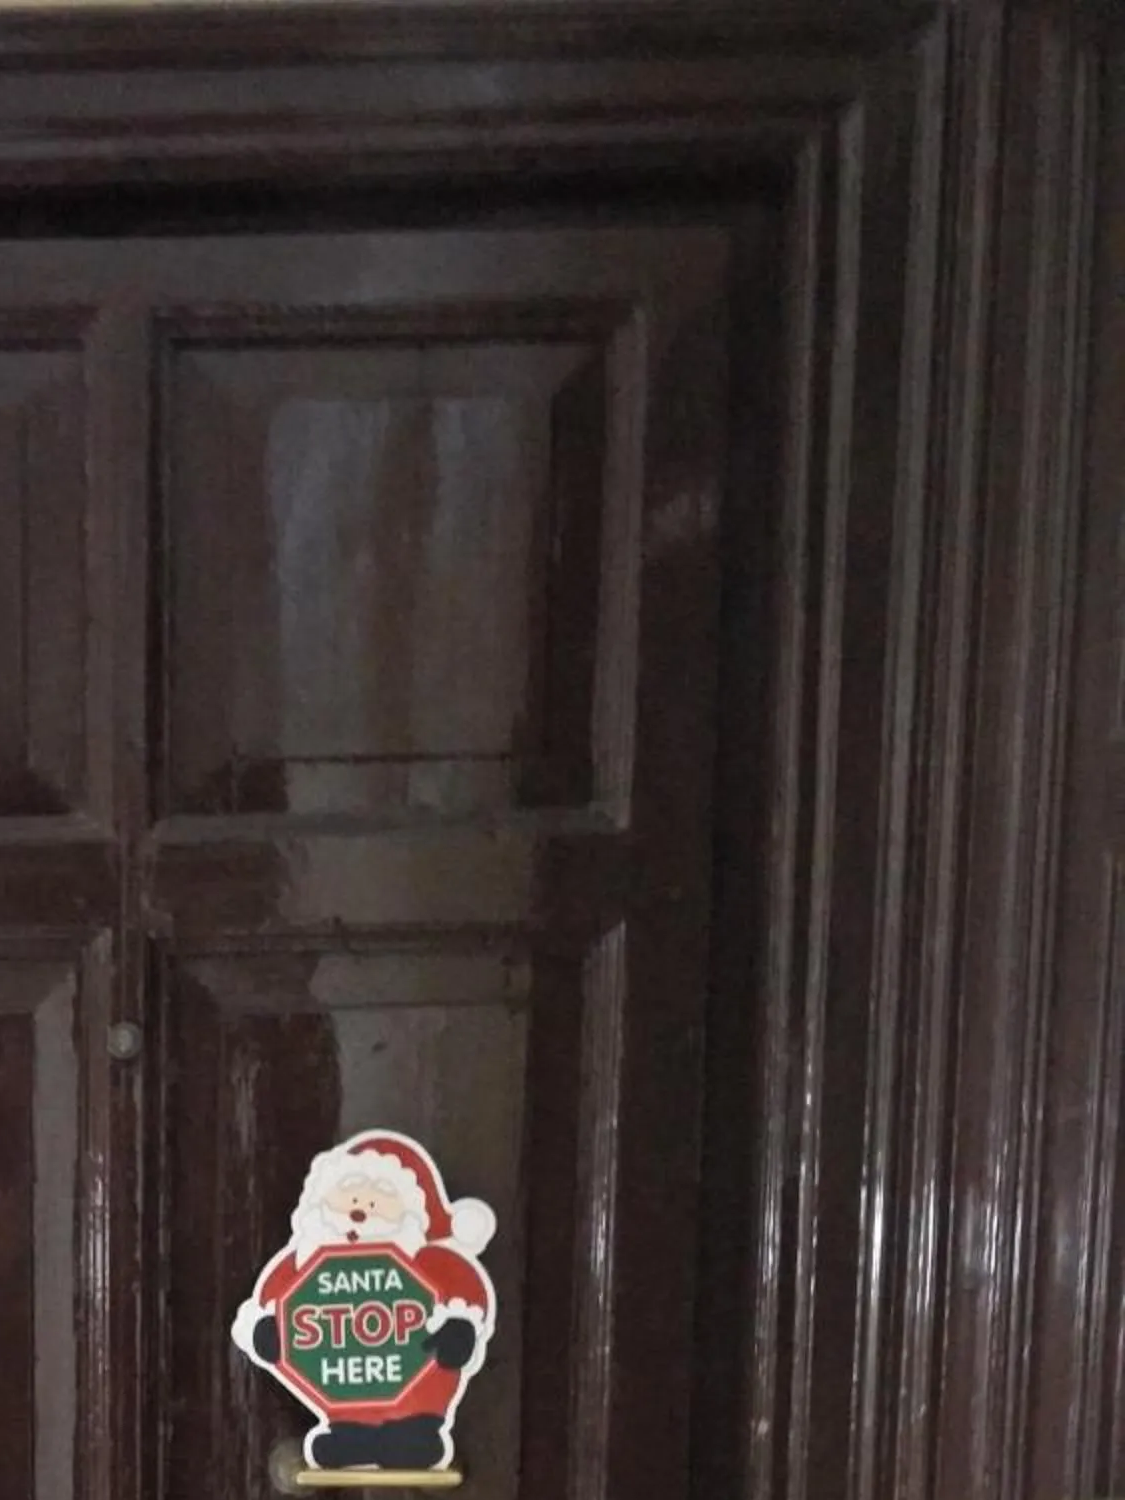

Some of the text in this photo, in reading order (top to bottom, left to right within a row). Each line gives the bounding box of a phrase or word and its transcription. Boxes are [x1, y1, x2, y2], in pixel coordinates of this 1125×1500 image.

[317, 1268, 404, 1294] SANTA
[292, 1300, 427, 1349] STOP
[321, 1355, 403, 1385] HERE
